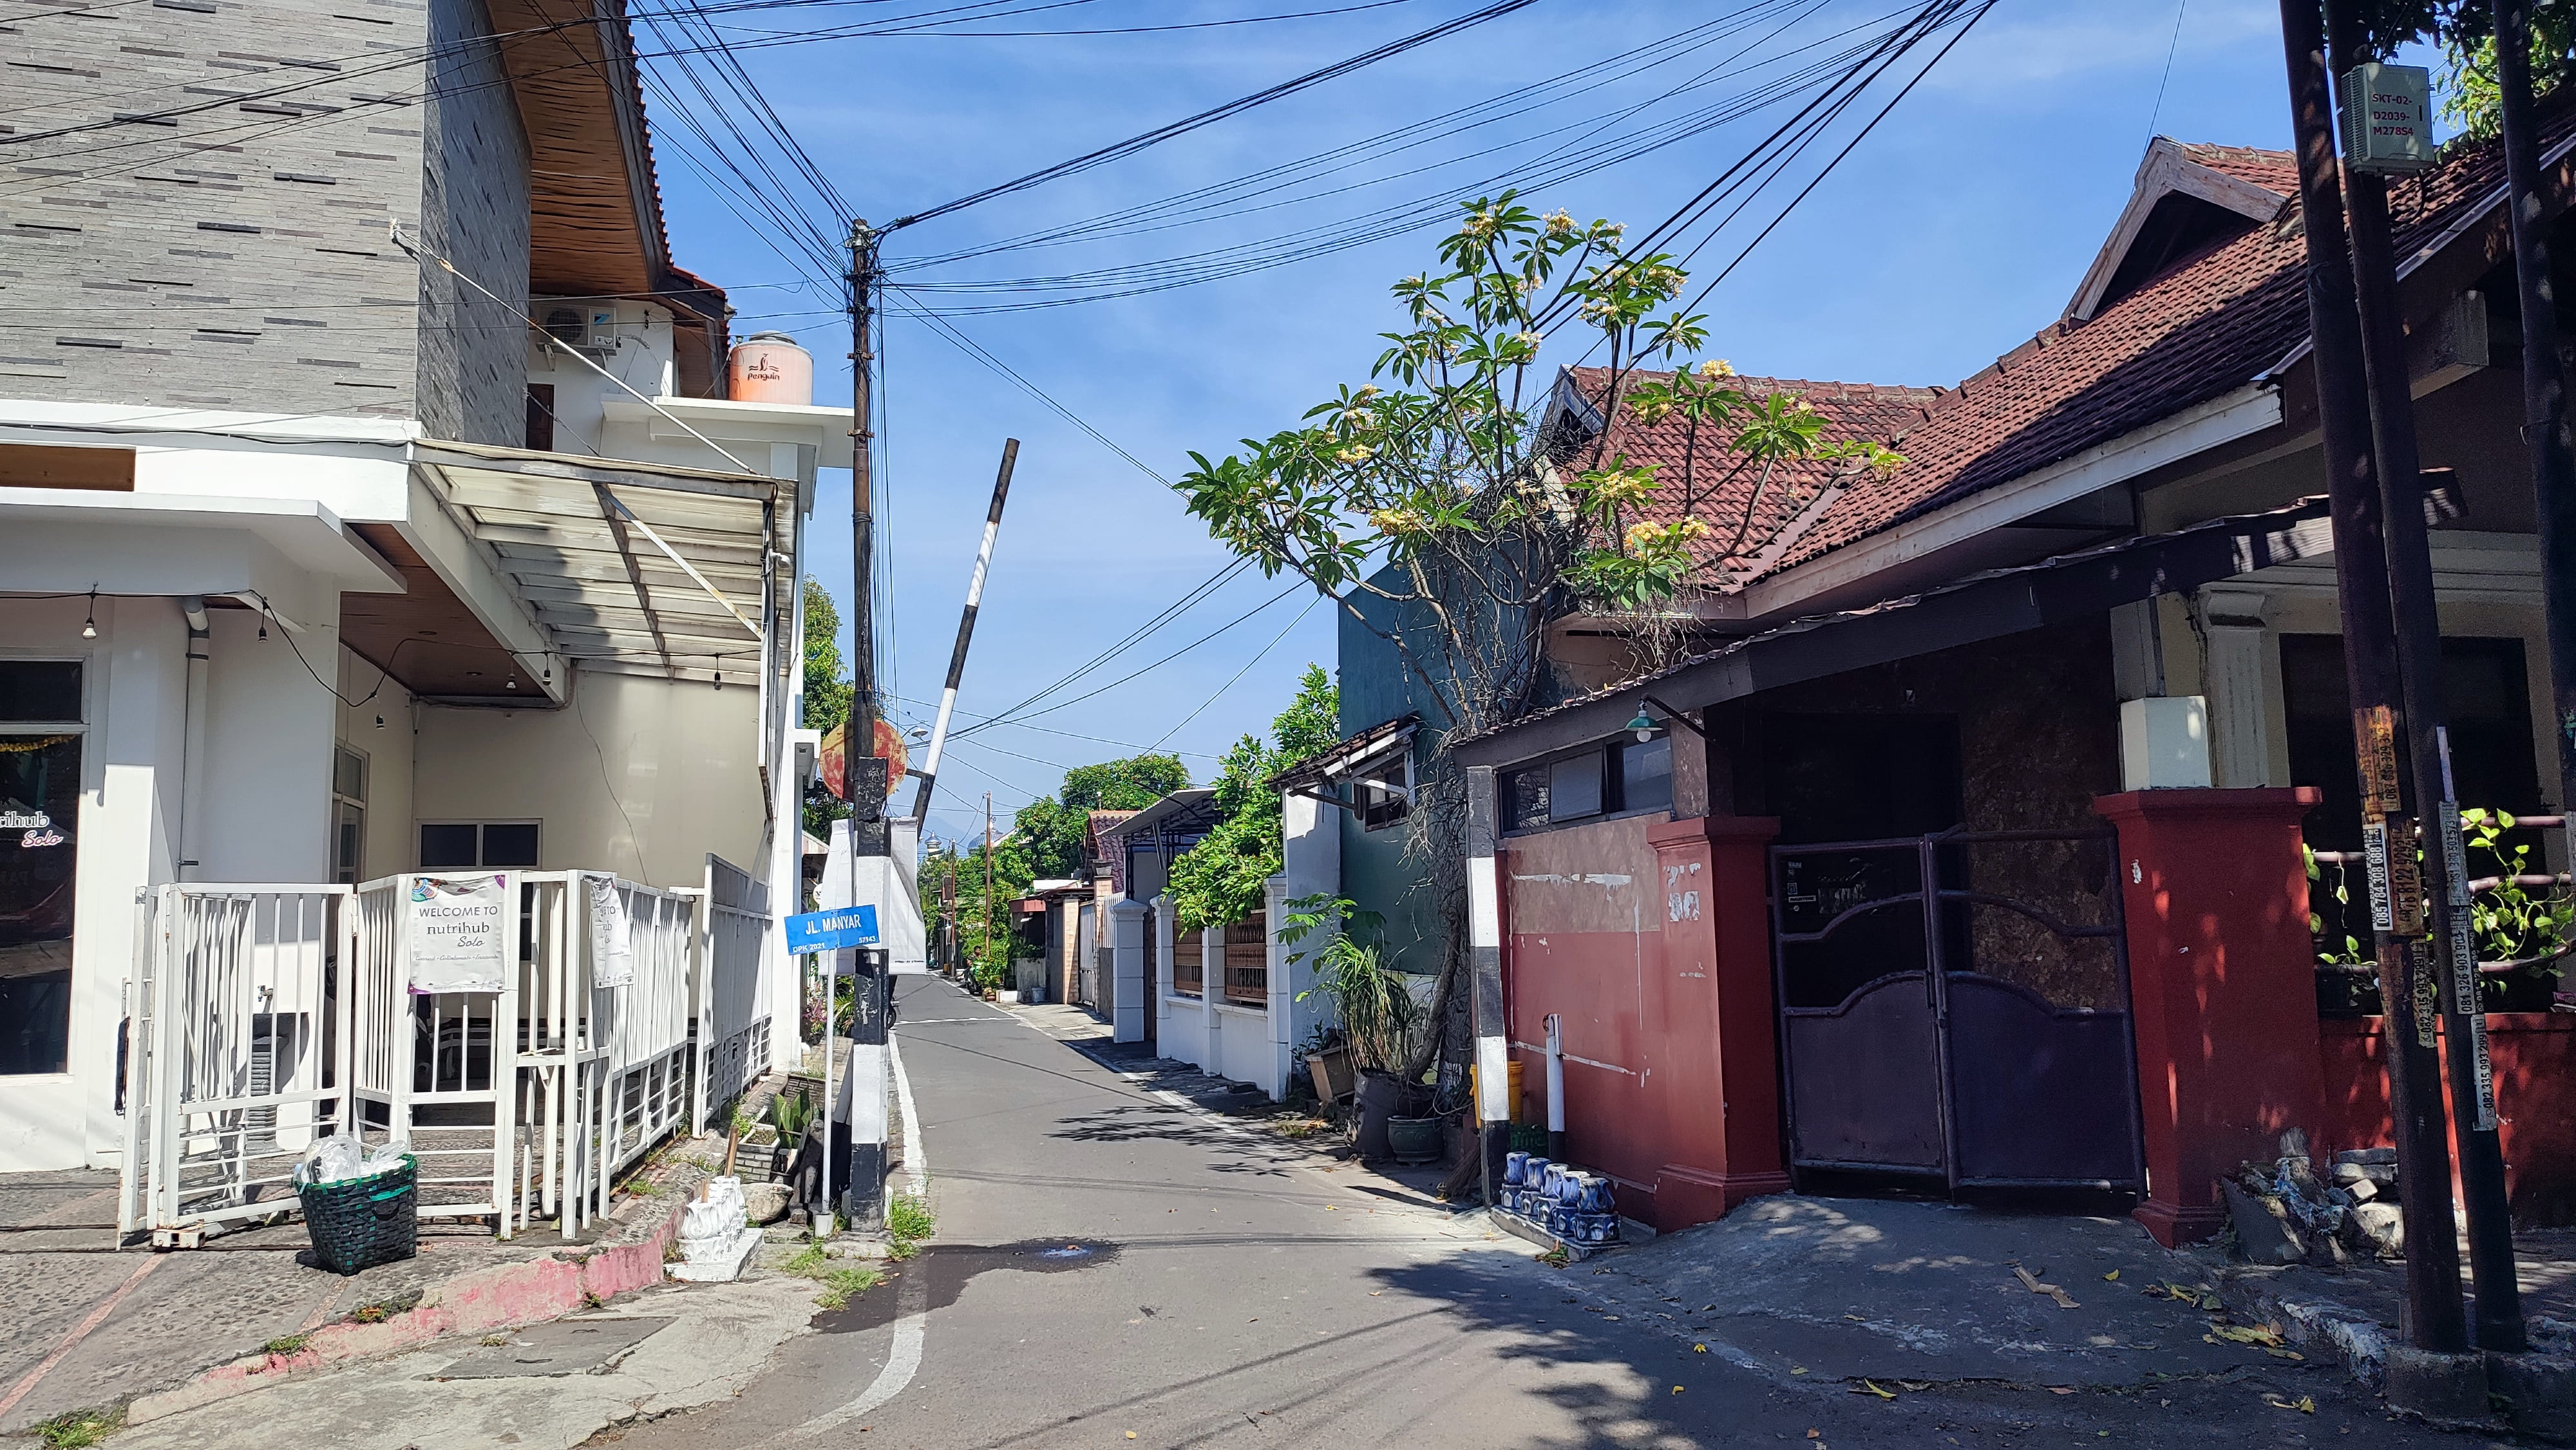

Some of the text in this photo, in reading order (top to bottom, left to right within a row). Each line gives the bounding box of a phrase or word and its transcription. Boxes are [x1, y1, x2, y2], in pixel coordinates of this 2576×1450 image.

[2372, 93, 2412, 105] SKT-02-
[2372, 111, 2410, 121] D2039-
[21, 830, 64, 847] Solo
[2369, 846, 2383, 864] 688
[2372, 866, 2385, 884] 308
[2374, 886, 2387, 904] 784
[419, 905, 498, 917] WELCOME TO
[2375, 906, 2389, 924] 085
[427, 921, 489, 934] nutrihub
[822, 914, 862, 932] MANYAR
[458, 936, 485, 947] Solo
[792, 942, 825, 953] DPK 2021
[858, 935, 876, 943] 57143
[2414, 958, 2425, 975] 299
[2456, 953, 2468, 971] 903
[2416, 977, 2427, 995] 993
[2458, 974, 2470, 992] 326
[2459, 994, 2472, 1012] 081
[2477, 1035, 2487, 1051] 299
[2479, 1053, 2490, 1070] 993
[2481, 1072, 2492, 1089] 335
[2482, 1092, 2494, 1108] 082
